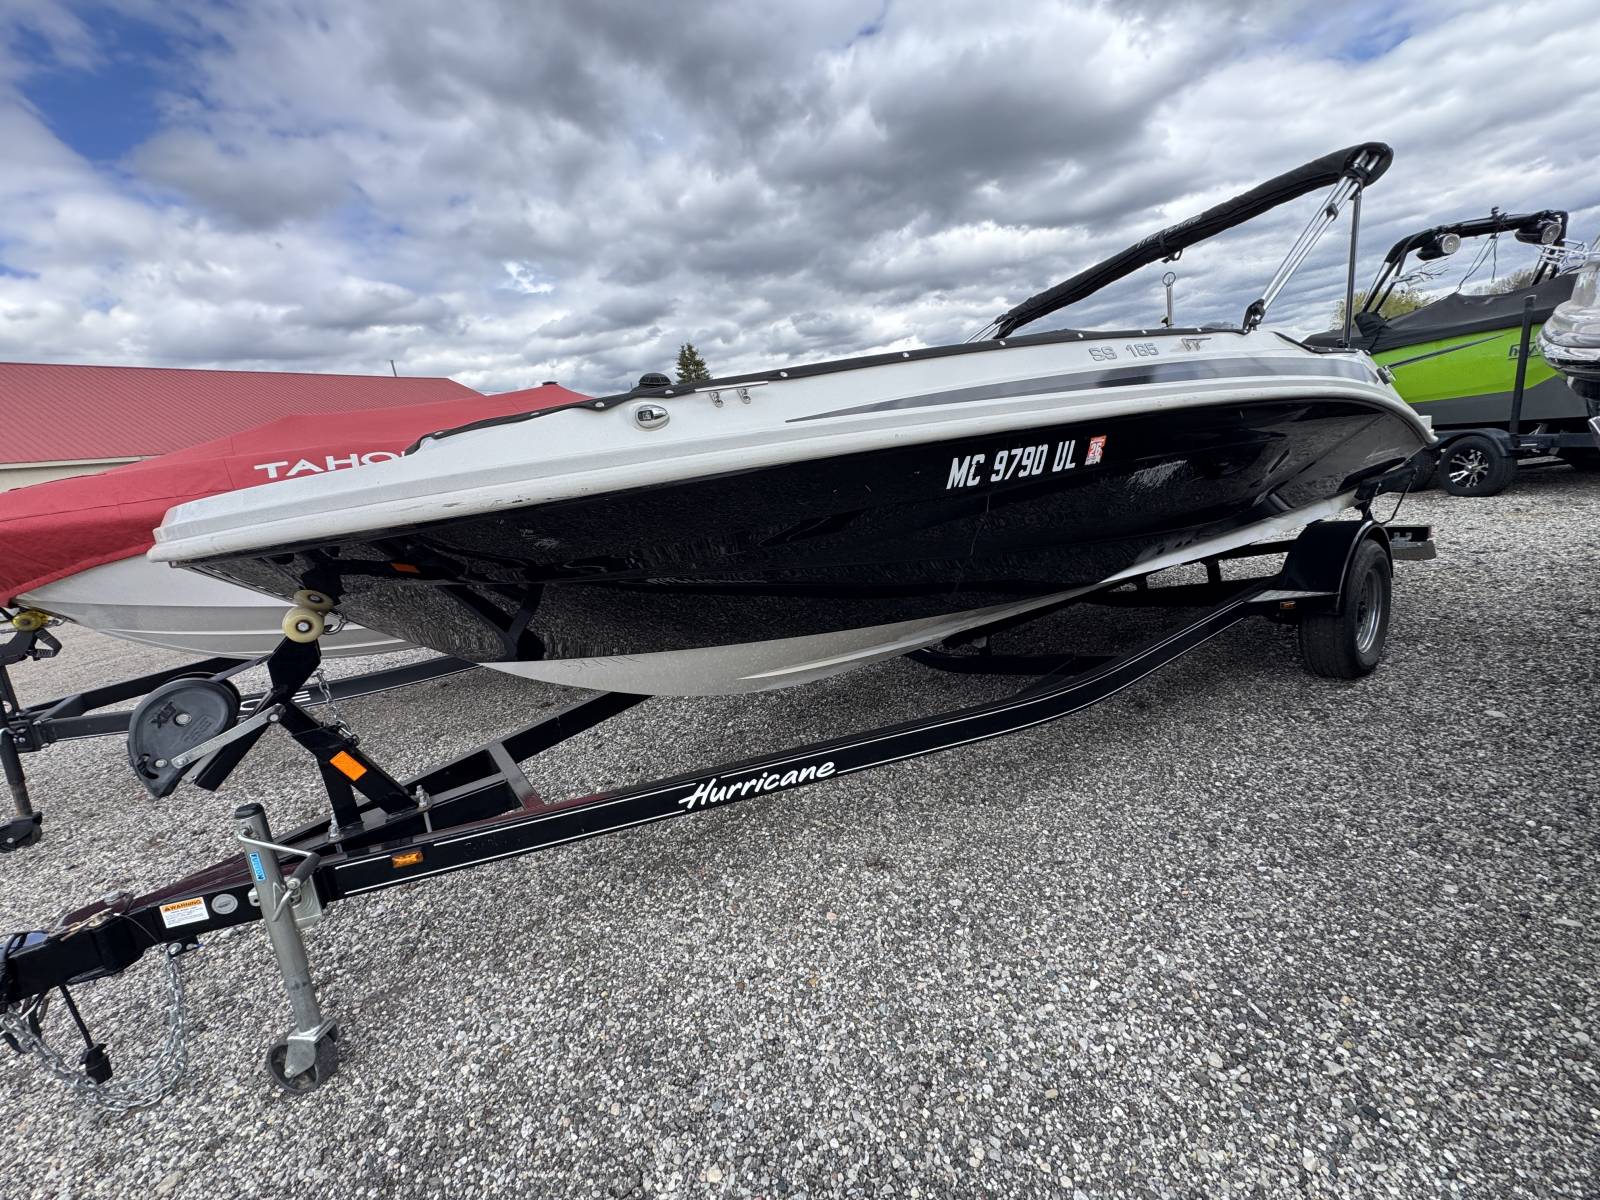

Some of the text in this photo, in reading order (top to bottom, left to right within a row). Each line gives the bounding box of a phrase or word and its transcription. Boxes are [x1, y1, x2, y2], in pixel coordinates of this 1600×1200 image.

[1088, 346, 1118, 361] SS
[254, 451, 405, 478] TAHO
[946, 440, 1076, 489] MC 9790 UL
[678, 761, 836, 809] Hurricane
[170, 900, 203, 911] WARNING
